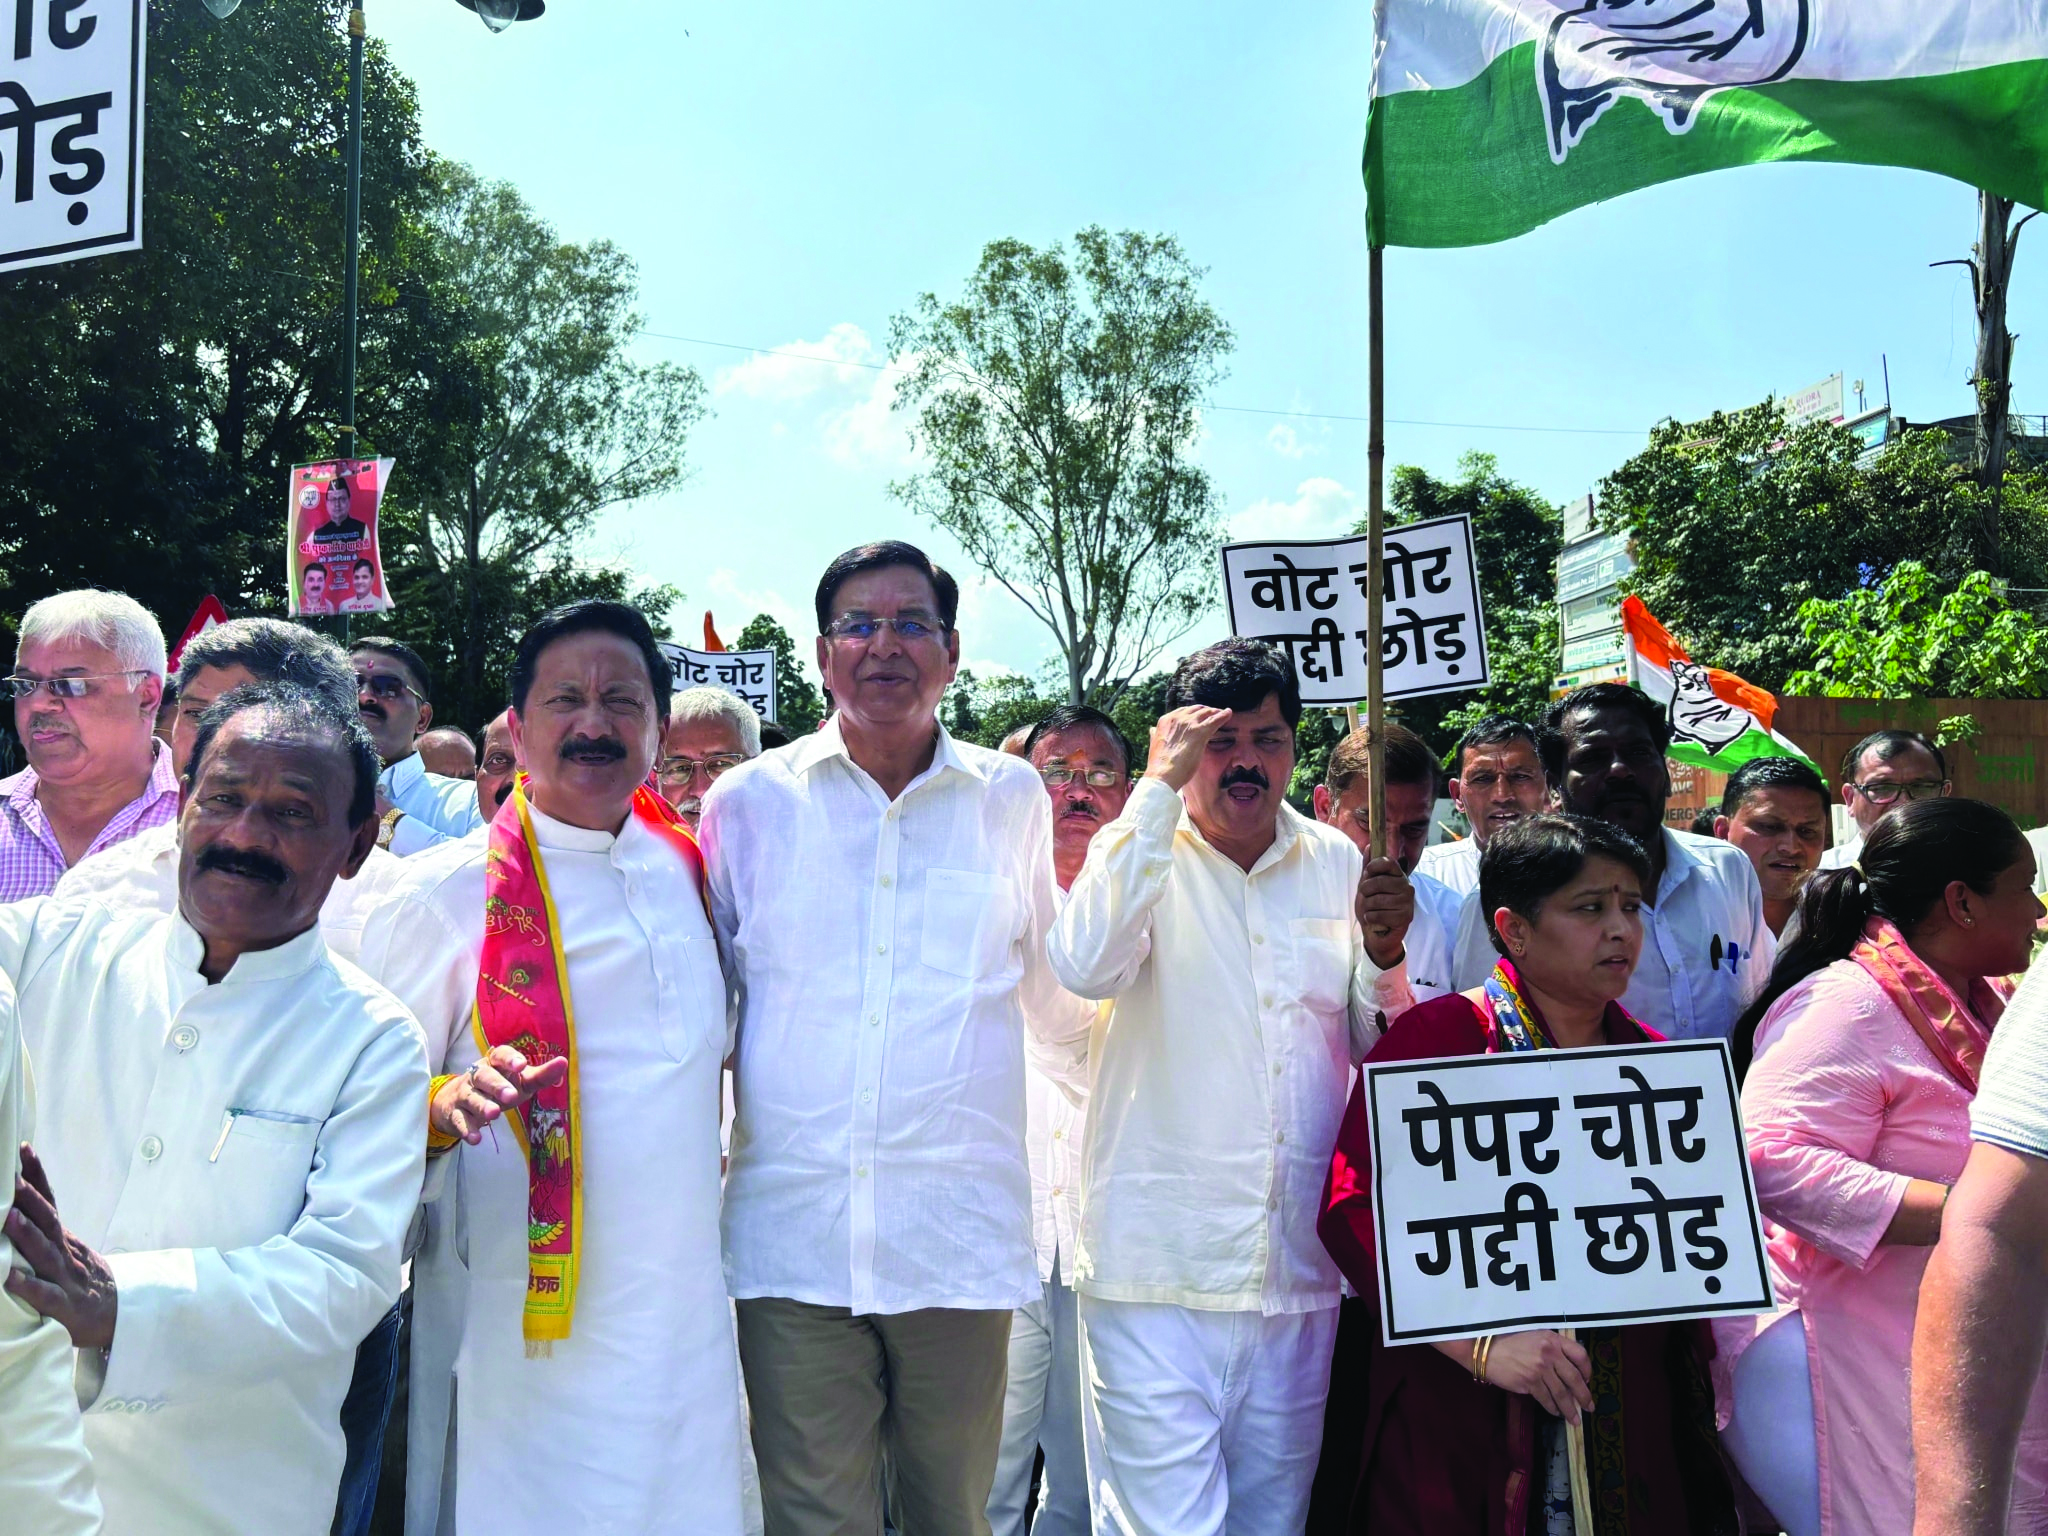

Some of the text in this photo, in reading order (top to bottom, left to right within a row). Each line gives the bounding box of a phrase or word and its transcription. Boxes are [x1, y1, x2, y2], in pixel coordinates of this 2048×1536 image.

[0, 81, 112, 226] ोड़
[1244, 553, 1339, 612] वोट
[715, 658, 765, 686] चोर
[1671, 780, 1694, 793] AVE
[1402, 1065, 1706, 1182] पेपर चोर
[1406, 1177, 1729, 1295] गद्दी छोड़
